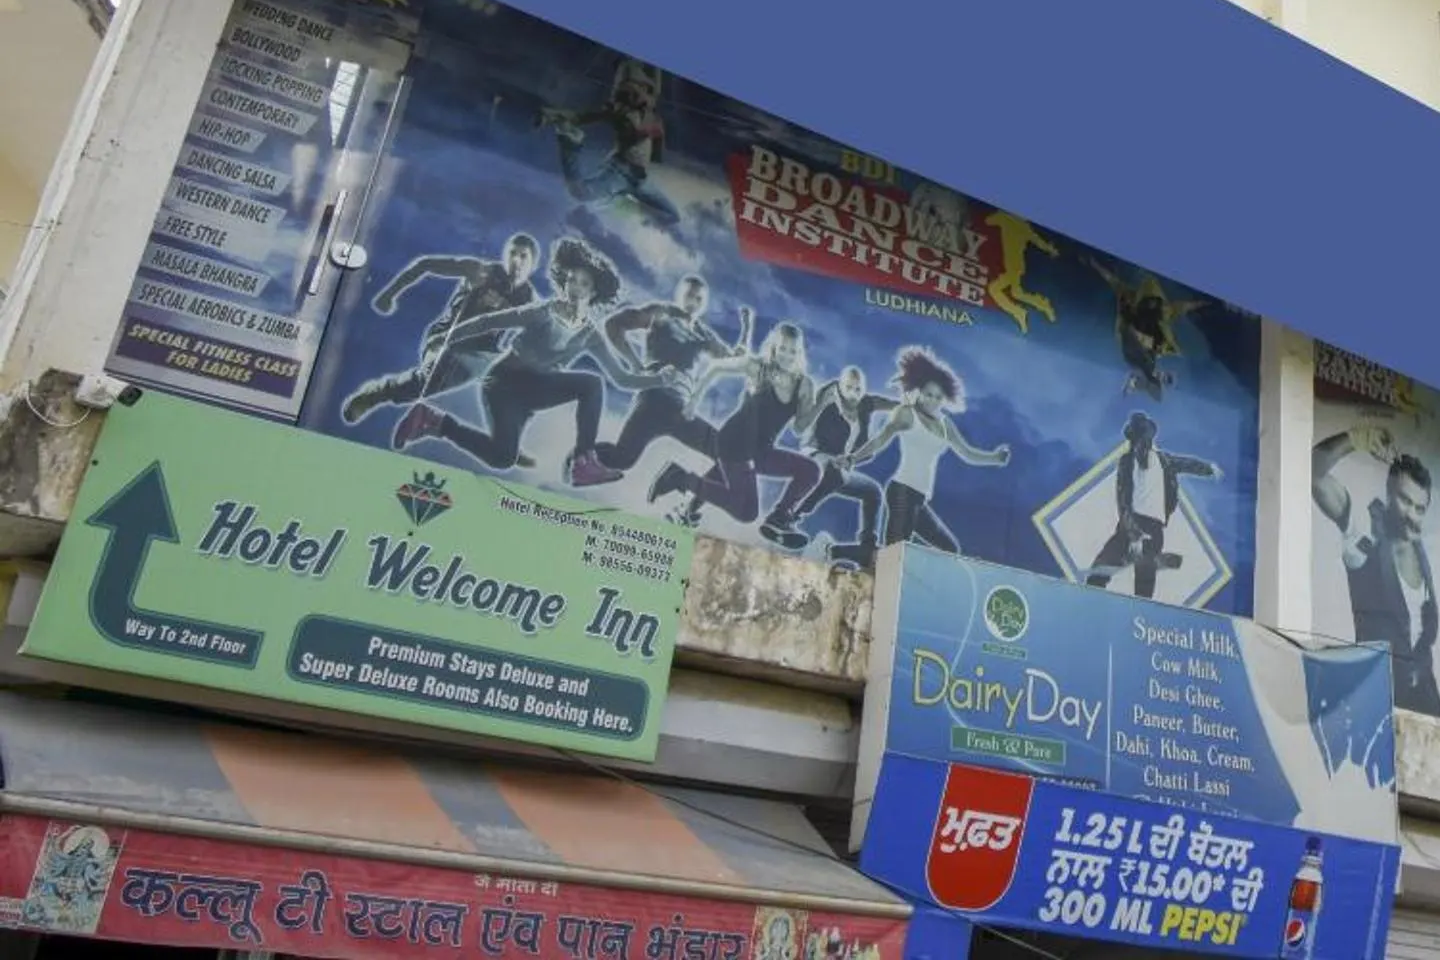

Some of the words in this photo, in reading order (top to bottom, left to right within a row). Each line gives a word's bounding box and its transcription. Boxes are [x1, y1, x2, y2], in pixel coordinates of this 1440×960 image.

[243, 0, 298, 29] WEDDING
[232, 27, 303, 63] BOLLYWOOD
[220, 57, 272, 87] LOCKING
[210, 89, 301, 129] CONTEMPORARY
[199, 118, 251, 147] HIP-HOP
[187, 150, 243, 180] DANCING
[243, 168, 277, 191] SALSA
[176, 181, 229, 212] WESTERN
[230, 204, 271, 224] DANCE
[751, 144, 988, 261] BROADWAY
[164, 216, 191, 238] FREE
[193, 226, 228, 248] STYLE
[745, 175, 988, 286] DANCE
[151, 249, 200, 279] MASALA
[200, 264, 259, 293] BHANGRA
[740, 198, 987, 307] INSTITUTE
[138, 285, 186, 310] SPECIAL
[189, 297, 247, 326] AEROBICS
[247, 315, 256, 329] &
[257, 317, 300, 341] ZUMBA
[865, 288, 974, 326] LUDHIANA
[128, 324, 190, 351] SPECIAL
[193, 341, 252, 366] FITNESS
[165, 352, 197, 368] FOR
[200, 359, 253, 383] LADIES
[501, 497, 530, 514] Hotel
[199, 500, 347, 577] Hotel
[367, 532, 567, 635] Welcome
[584, 586, 661, 660] Inn
[126, 618, 157, 641] Way
[160, 624, 176, 642] To
[178, 629, 206, 648] 2nd
[210, 634, 246, 655] Floor
[1133, 614, 1194, 650] Special
[368, 636, 445, 670] Premium
[450, 651, 496, 682] Stays
[499, 661, 554, 691] Deluxe
[557, 677, 591, 697] and
[1152, 652, 1181, 673] Cow
[300, 652, 353, 682] Super
[357, 663, 418, 693] Deluxe
[422, 675, 479, 705] Rooms
[483, 687, 519, 712] Also
[523, 694, 589, 728] Booking
[592, 707, 634, 734] Here.
[1150, 679, 1179, 701] Desi
[1186, 685, 1225, 712] Ghee,
[1193, 715, 1240, 744] Butter,
[1144, 765, 1188, 790] Chatti
[1194, 774, 1230, 796] Lassi
[1150, 814, 1185, 861] ਦੀ
[1046, 849, 1112, 889] ਨਾਲ
[1230, 867, 1264, 913] ਦੀ
[120, 867, 262, 944] कल्लू
[274, 869, 332, 934] टी
[344, 891, 469, 947] स्टाल
[556, 912, 634, 960] पान
[1039, 887, 1106, 926] 300
[1110, 899, 1153, 936] ML
[1160, 907, 1242, 946] PEPSI
